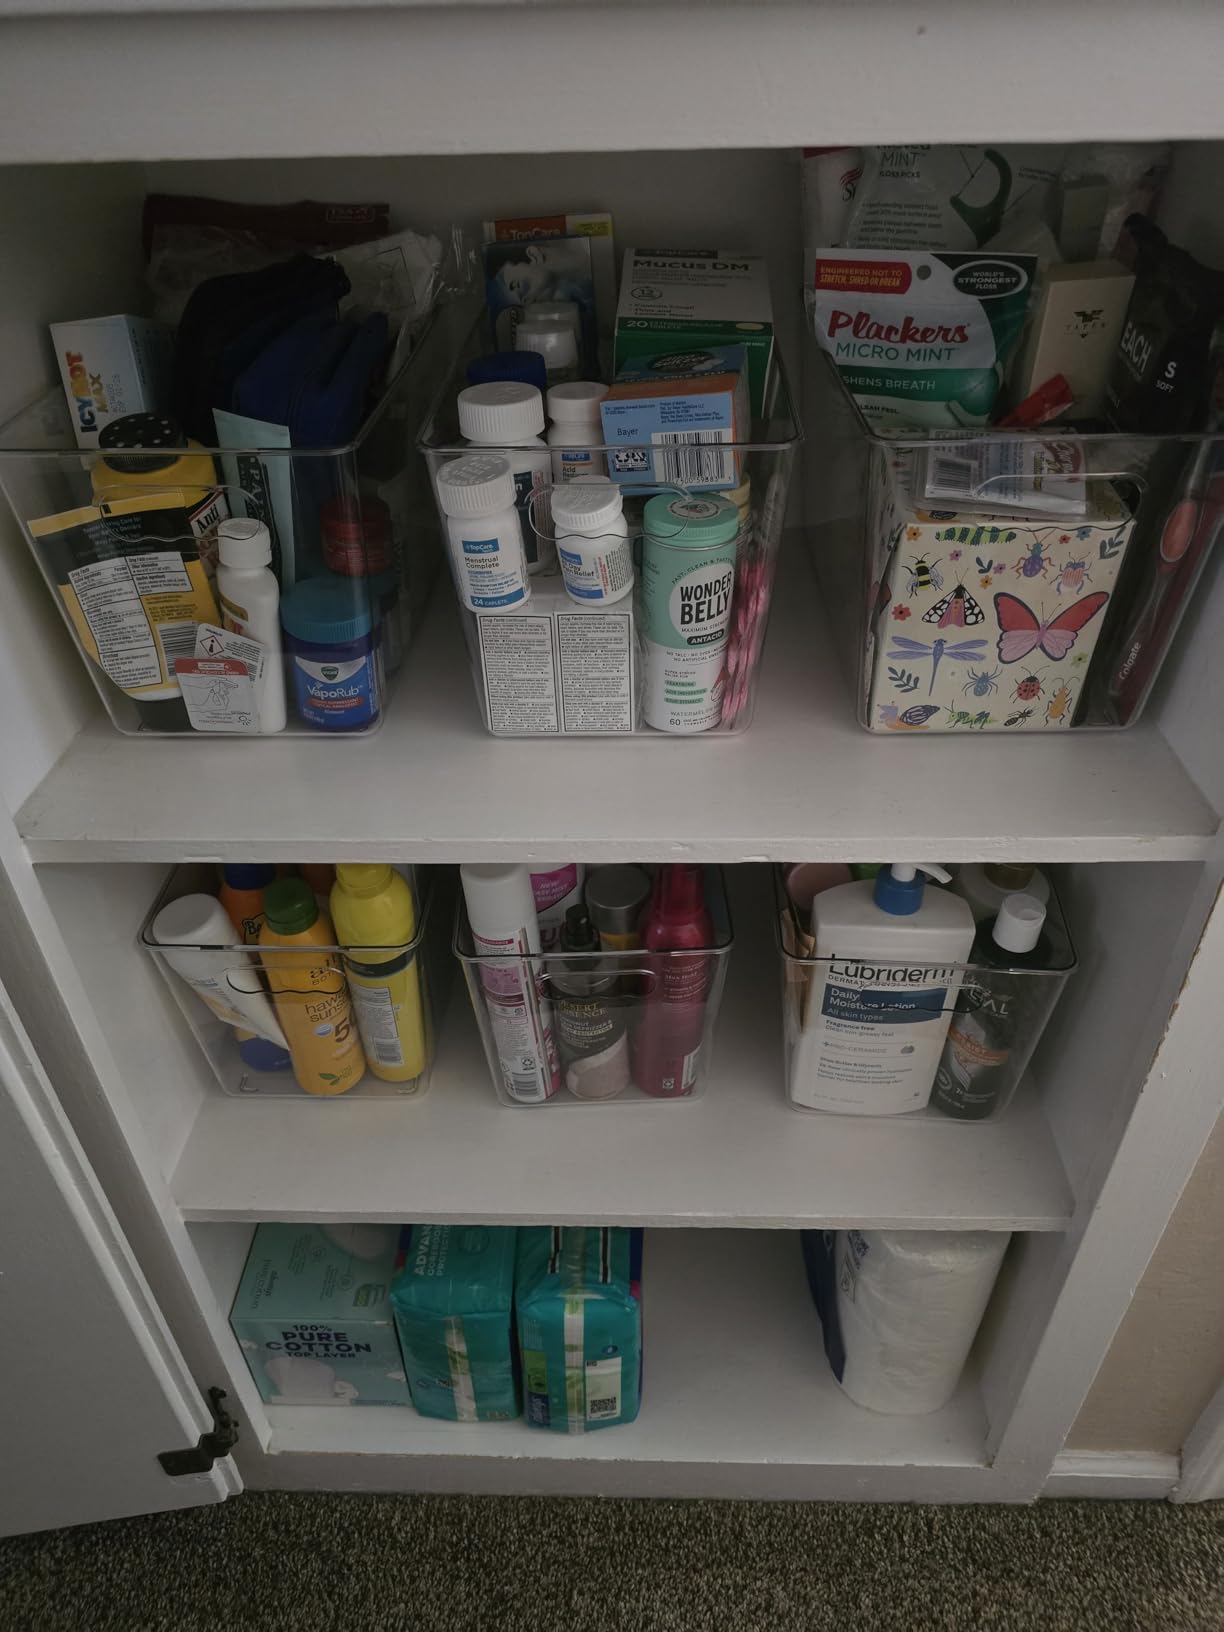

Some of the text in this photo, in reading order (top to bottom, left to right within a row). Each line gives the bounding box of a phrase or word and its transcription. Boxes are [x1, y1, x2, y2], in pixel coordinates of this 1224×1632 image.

[633, 259, 749, 272] Mucus DM
[820, 267, 870, 276] ENGINEERED
[972, 270, 1005, 278] WORLD'S
[849, 276, 868, 284] SHRED
[870, 278, 879, 286] OR
[880, 278, 900, 287] BREAK
[957, 276, 1017, 285] STRONGEST
[626, 319, 649, 329] 20
[827, 310, 970, 345] Plackers
[835, 341, 955, 362] MICRO MINT
[1163, 360, 1178, 380] S
[842, 374, 937, 392] SHENS BREATH
[1154, 378, 1176, 394] SOFT
[616, 427, 639, 438] Bayer
[562, 465, 577, 473] Acid
[196, 502, 220, 534] Anti
[469, 544, 494, 552] TopCare
[464, 555, 499, 564] Menstrual
[466, 562, 500, 570] Complete
[671, 571, 688, 586] FAST,
[687, 560, 709, 574] CLEAN
[680, 570, 732, 603] WONDER
[473, 597, 484, 606] 24
[680, 587, 731, 625] BELLY
[681, 625, 708, 633] MAXIMUM
[691, 631, 723, 645] ANTACID
[306, 684, 360, 700] VapoRub
[669, 718, 681, 726] 60
[829, 953, 955, 984] Lubriderm
[830, 987, 861, 1001] Daily
[825, 1006, 839, 1016] All
[291, 1324, 333, 1333] 100%
[280, 1331, 349, 1343] PURE
[264, 1340, 372, 1353] COTTON
[315, 1351, 356, 1359] LAYER
